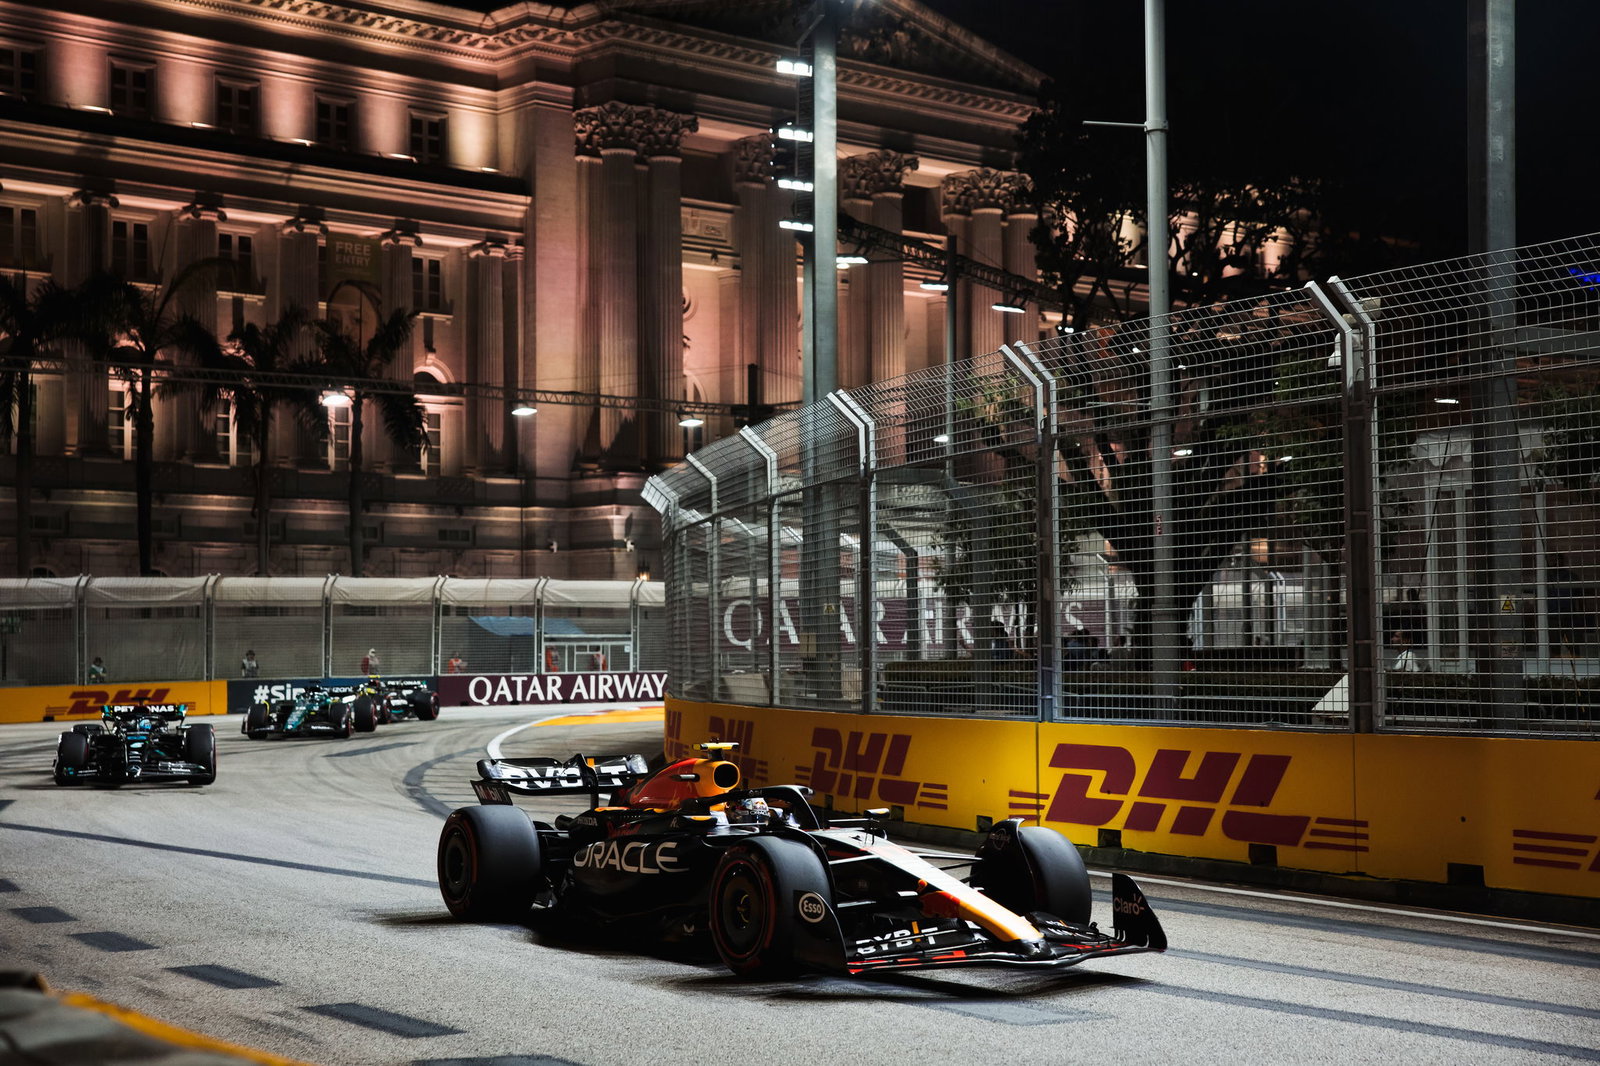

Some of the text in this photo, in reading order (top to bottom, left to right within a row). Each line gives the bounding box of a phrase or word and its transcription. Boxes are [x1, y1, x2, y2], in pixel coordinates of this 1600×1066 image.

[335, 241, 371, 256] FREE
[335, 254, 371, 267] ENTRY
[468, 675, 563, 706] QATAR
[810, 727, 921, 805] DHL
[1045, 743, 1312, 847] DHL
[573, 840, 690, 875] ORACLE
[803, 901, 822, 914] Esso
[1113, 897, 1140, 916] Claro
[856, 921, 938, 955] BYBIT
